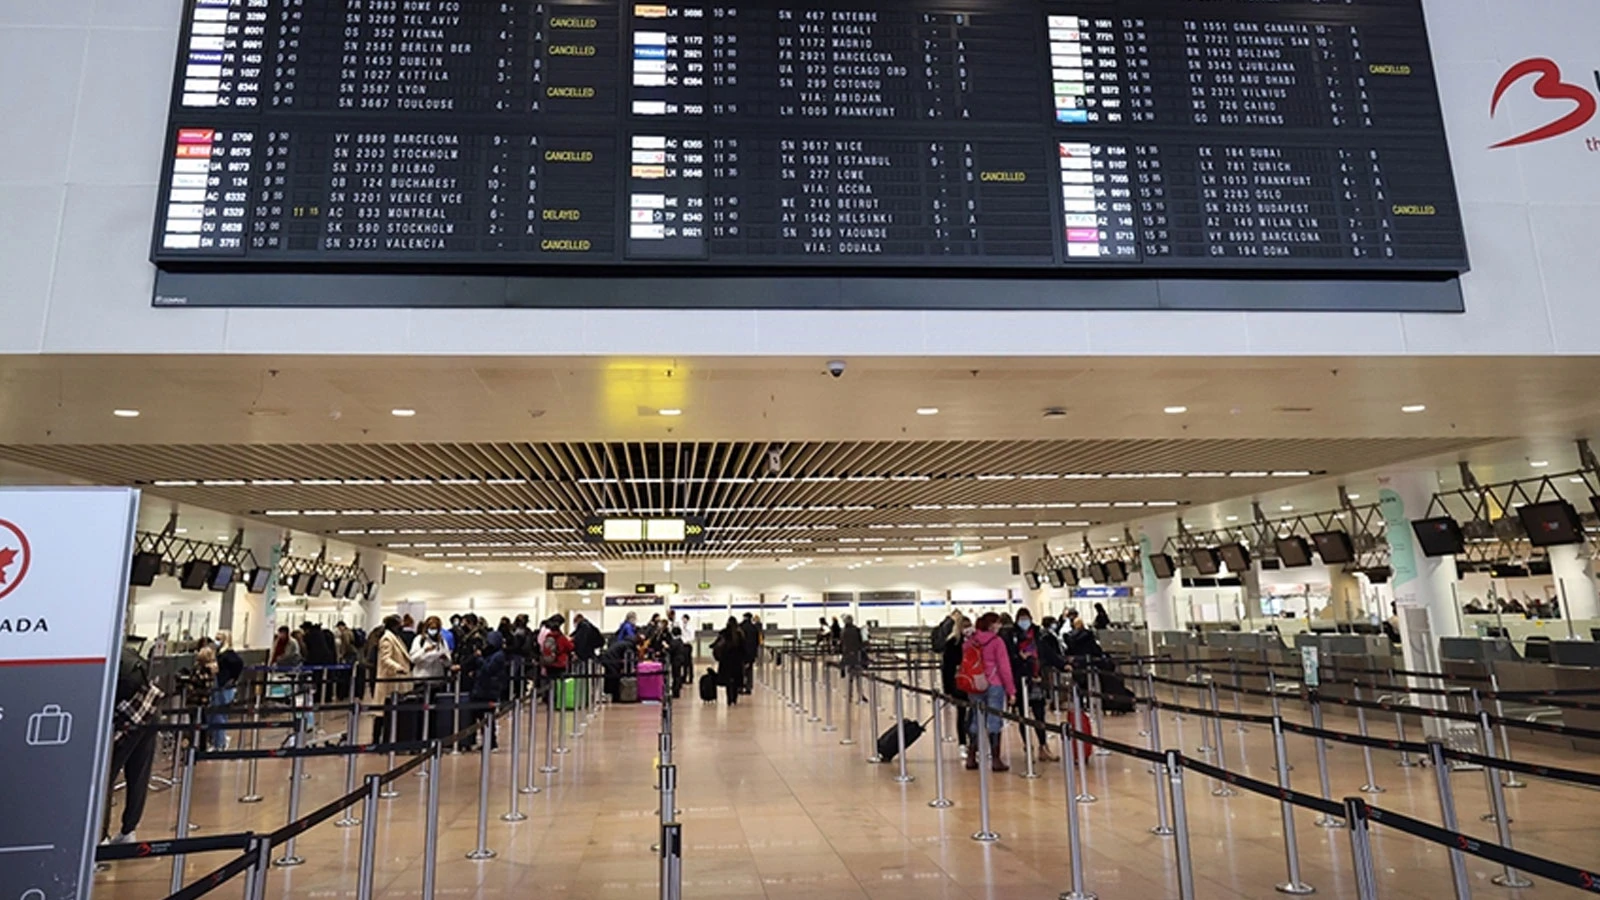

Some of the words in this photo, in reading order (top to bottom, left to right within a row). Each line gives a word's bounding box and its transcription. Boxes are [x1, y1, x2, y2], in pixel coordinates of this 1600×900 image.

[347, 0, 361, 9] FR
[403, 1, 430, 11] ROME
[439, 2, 459, 11] FCO
[346, 13, 361, 23] SN
[404, 15, 423, 25] TEL
[431, 16, 459, 25] AVIV
[550, 18, 597, 28] CANCELLED
[778, 10, 792, 19] SN
[832, 12, 877, 22] ENTEBBE
[799, 24, 826, 33] VIA:
[832, 25, 871, 35] KIGALI
[1184, 21, 1196, 31] TB
[1233, 23, 1259, 32] GRAN
[1264, 24, 1308, 33] CANARIA
[345, 27, 359, 37] OS
[402, 29, 444, 39] VIENNA
[832, 39, 873, 48] MADRID
[1185, 34, 1198, 43] TK
[1236, 36, 1284, 46] ISTANBUL
[344, 42, 358, 51] SN
[400, 43, 443, 52] BERLIN
[450, 44, 471, 53] BER
[549, 46, 595, 55] CANCELLED
[1237, 49, 1281, 58] BOLZANO
[342, 55, 357, 64] FR
[399, 57, 443, 66] DUBLIN
[779, 51, 793, 60] FR
[833, 52, 893, 62] BARCELONA
[779, 65, 793, 73] UA
[833, 66, 880, 75] CHICAGO
[886, 67, 907, 76] ORD
[1188, 61, 1201, 70] SN
[1239, 62, 1295, 72] LJUBLJANA
[1369, 65, 1411, 75] CANCELLED
[341, 69, 356, 79] SN
[398, 71, 449, 80] KITTILA
[779, 78, 793, 87] SN
[834, 79, 881, 89] COTONOU
[1241, 76, 1259, 84] ABU
[1266, 76, 1296, 85] DHABI
[340, 84, 355, 93] SN
[397, 85, 426, 94] LYON
[547, 88, 595, 97] CANCELLED
[1191, 87, 1204, 96] SN
[1242, 88, 1287, 98] VILNIUS
[339, 98, 354, 108] SN
[397, 98, 454, 109] TOULOUSE
[800, 93, 826, 102] VIA:
[834, 93, 882, 103] ABIDJAN
[780, 106, 794, 115] LH
[835, 107, 896, 117] FRANKFURT
[1244, 101, 1276, 111] CAIRO
[1245, 115, 1284, 124] ATHENS
[335, 134, 349, 143] VY
[393, 134, 459, 144] BARCELONA
[781, 141, 795, 150] SN
[836, 142, 863, 151] NICE
[334, 148, 349, 157] SN
[393, 149, 458, 159] STOCKHOLM
[545, 151, 593, 161] CANCELLED
[1250, 148, 1282, 157] DUBAI
[781, 155, 795, 164] TK
[837, 156, 891, 166] ISTANBUL
[332, 163, 348, 172] SN
[391, 164, 436, 173] BILBAO
[1200, 162, 1214, 171] LX
[1253, 162, 1291, 171] ZURICH
[782, 170, 796, 178] SN
[837, 171, 864, 179] LOME
[980, 172, 1026, 181] CANCELLED
[1202, 176, 1216, 184] LH
[1254, 176, 1311, 185] FRANKFURT
[390, 178, 457, 188] BUCHAREST
[803, 184, 829, 193] VIA:
[837, 185, 872, 194] ACCRA
[1204, 189, 1217, 198] SN
[1255, 190, 1282, 199] OSLO
[330, 192, 345, 202] SN
[390, 193, 432, 203] VENICE
[441, 194, 463, 204] VCE
[838, 199, 879, 209] BEIRUT
[1205, 203, 1219, 212] SN
[1258, 204, 1309, 213] BUDAPEST
[1392, 205, 1436, 214] CANCELLED
[328, 208, 344, 217] AC
[388, 208, 446, 218] MONTREAL
[542, 210, 580, 219] DELAYED
[782, 213, 796, 222] AY
[838, 214, 893, 224] HELSINKI
[1207, 218, 1220, 226] AZ
[1259, 218, 1291, 227] MILAN
[1298, 219, 1318, 227] LIN
[327, 223, 342, 232] SK
[387, 223, 454, 234] STOCKHOLM
[783, 228, 797, 237] SN
[839, 229, 887, 238] YAOUNDE
[1209, 232, 1222, 240] VY
[1261, 232, 1320, 241] BARCELONA
[326, 238, 341, 248] SN
[386, 239, 445, 249] VALENCIA
[541, 240, 591, 249] CANCELLED
[804, 243, 831, 252] VIA:
[839, 243, 881, 253] DOUALA
[1263, 246, 1290, 255] DOHA
